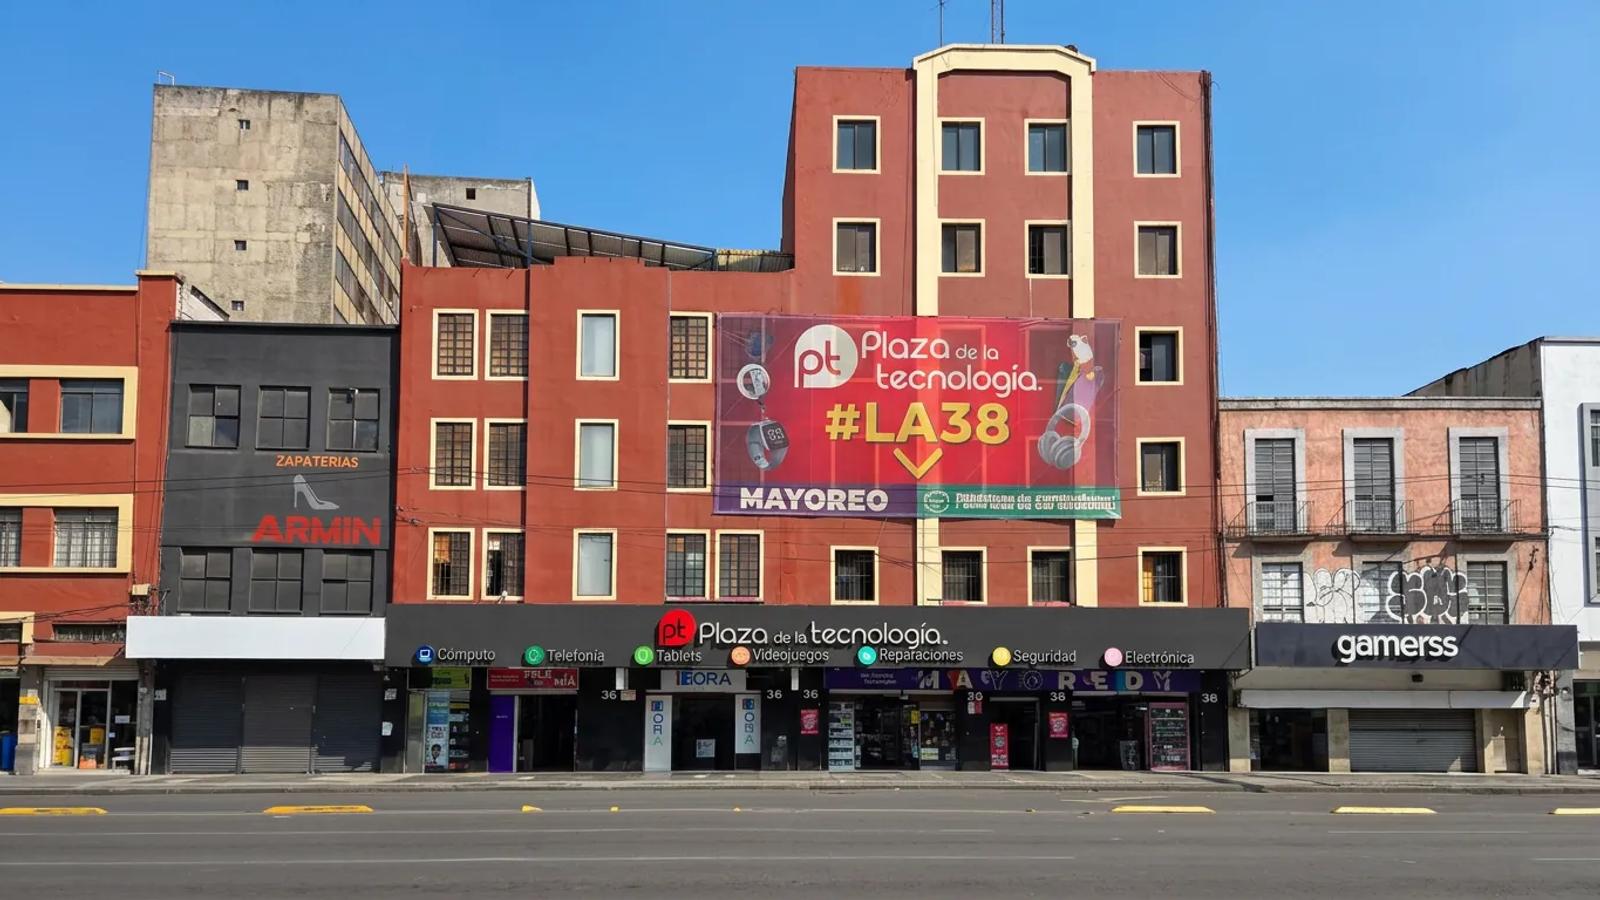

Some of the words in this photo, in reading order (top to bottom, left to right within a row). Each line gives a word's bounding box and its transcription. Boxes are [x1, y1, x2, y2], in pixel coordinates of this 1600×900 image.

[861, 330, 950, 359] Plaza
[955, 345, 977, 360] de
[983, 343, 999, 360] la
[825, 402, 1010, 445] #LA38
[276, 455, 359, 468] ZAPATERIAS
[739, 488, 889, 512] MAYOREO
[251, 515, 381, 545] ARMIN
[700, 621, 768, 645] Plaza
[773, 630, 790, 644] de
[793, 630, 807, 644] la
[437, 648, 496, 665] Cómputo
[656, 649, 702, 664] Tablets
[752, 648, 829, 667] Videojuegos
[880, 648, 964, 667] Reparaciones
[1013, 649, 1077, 667] Seguridad
[1337, 635, 1458, 663] gamerss
[601, 690, 617, 700] 36
[767, 689, 783, 699] 36
[802, 689, 818, 699] 36
